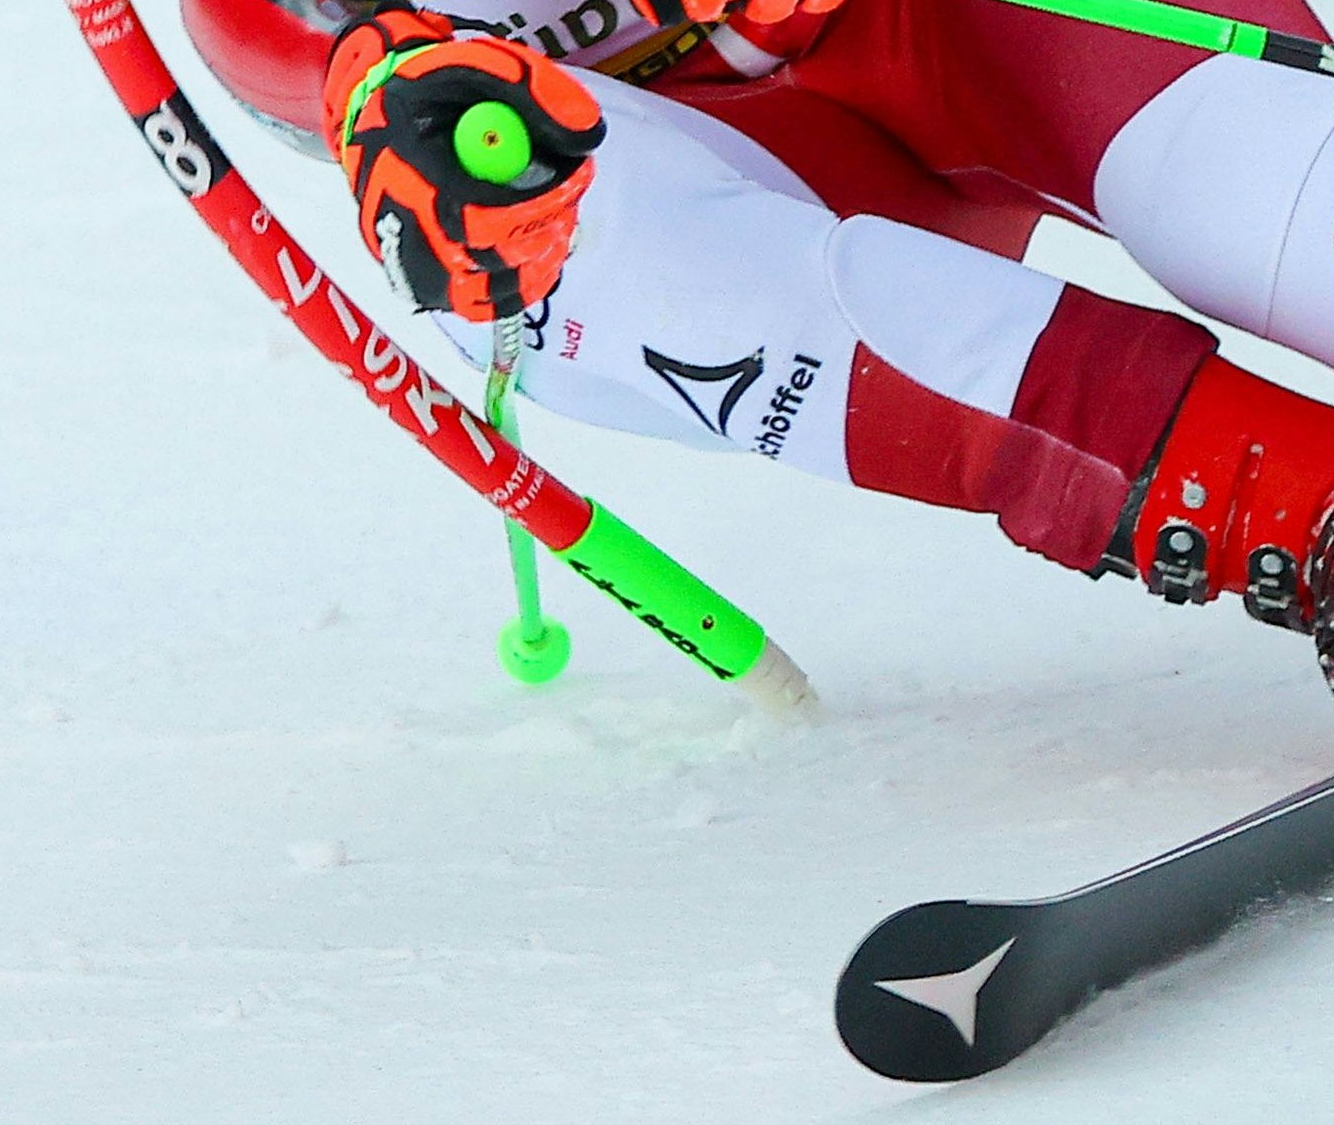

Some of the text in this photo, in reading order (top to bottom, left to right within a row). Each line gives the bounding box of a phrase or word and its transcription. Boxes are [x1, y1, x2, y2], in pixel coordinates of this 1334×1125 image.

[144, 99, 212, 200] 8
[276, 246, 496, 467] LISKI
[559, 318, 585, 362] Audi
